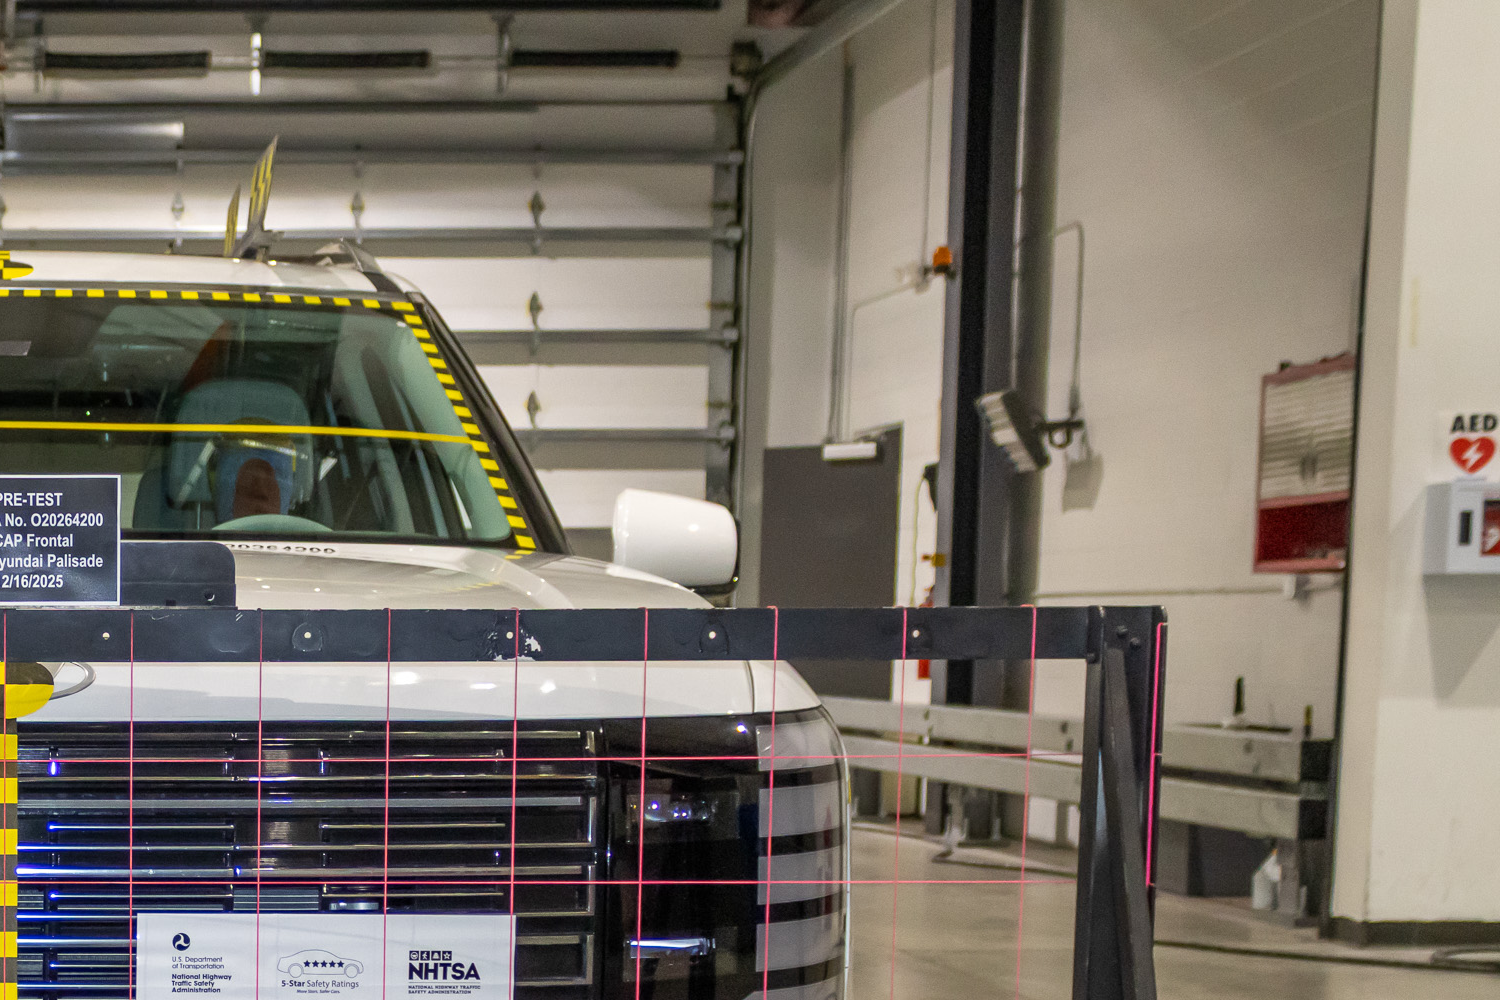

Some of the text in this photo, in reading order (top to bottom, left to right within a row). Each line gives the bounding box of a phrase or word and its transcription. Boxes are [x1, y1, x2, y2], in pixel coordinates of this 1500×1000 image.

[1450, 414, 1498, 432] AED
[5, 513, 27, 527] No.
[27, 534, 73, 547] Frontal
[47, 554, 103, 568] Palisade
[202, 973, 232, 981] Highway
[408, 962, 481, 980] NHTSA
[281, 979, 360, 989] 5-Star Safety Ratings
